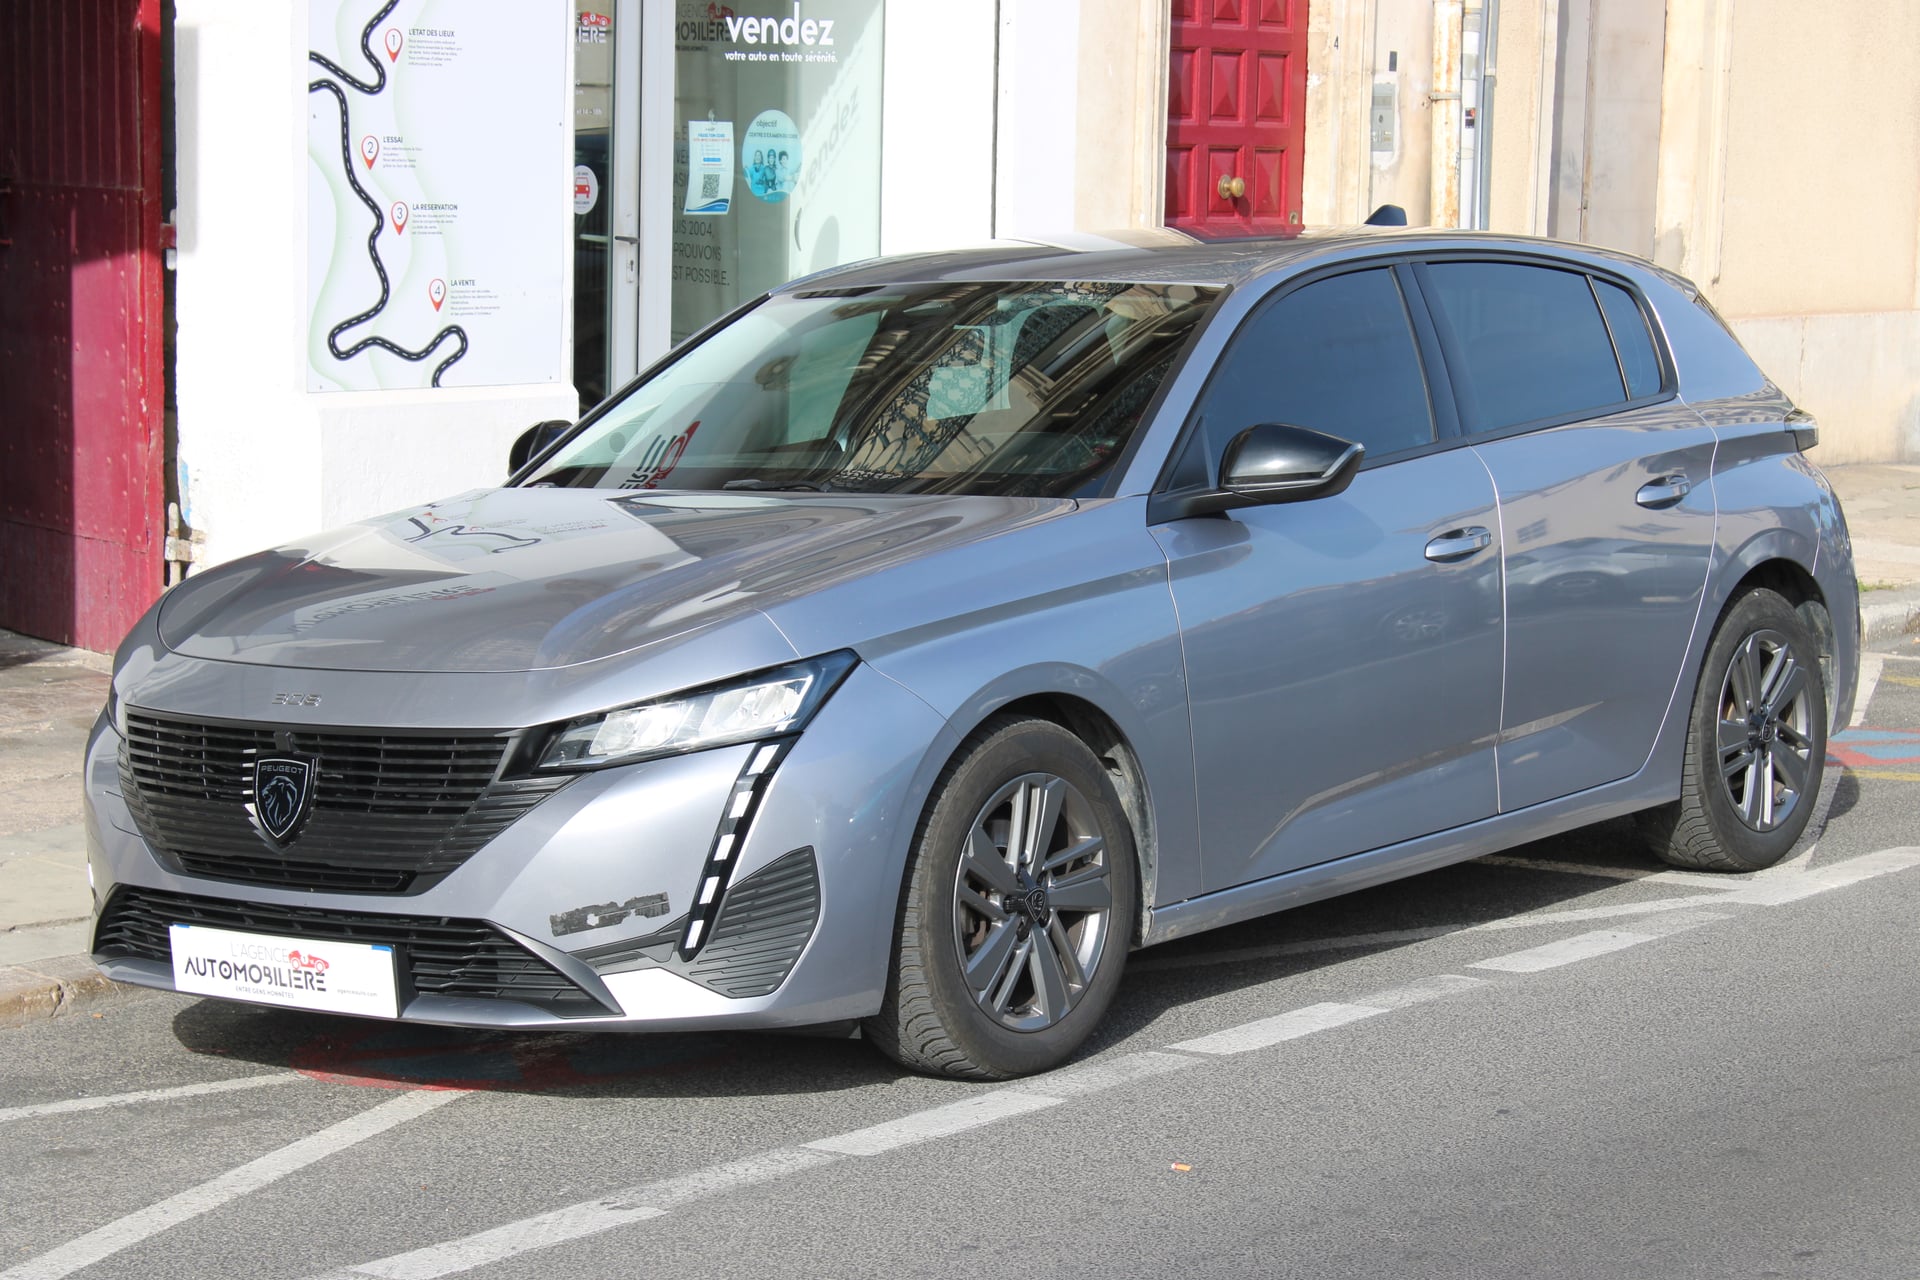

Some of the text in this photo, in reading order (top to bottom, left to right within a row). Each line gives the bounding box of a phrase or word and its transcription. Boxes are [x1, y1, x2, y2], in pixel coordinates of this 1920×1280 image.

[725, 1, 835, 45] vendez
[427, 29, 438, 37] DES
[438, 30, 456, 38] LIEUX
[391, 34, 396, 47] 1
[1333, 35, 1339, 50] 4
[724, 50, 839, 63] votre auto en toute sérénité.
[367, 141, 374, 154] 2
[396, 207, 403, 220] 3
[689, 220, 715, 239] 2004,
[685, 266, 730, 286] POSSIBLE.
[450, 279, 476, 287] LA VENTE
[434, 284, 441, 296] 4
[260, 764, 304, 774] PEUGEOT
[229, 941, 290, 964] L'AGENCE
[184, 956, 327, 992] AUTOMOBILIERE
[235, 985, 252, 994] ENTRE
[252, 987, 266, 996] GENS
